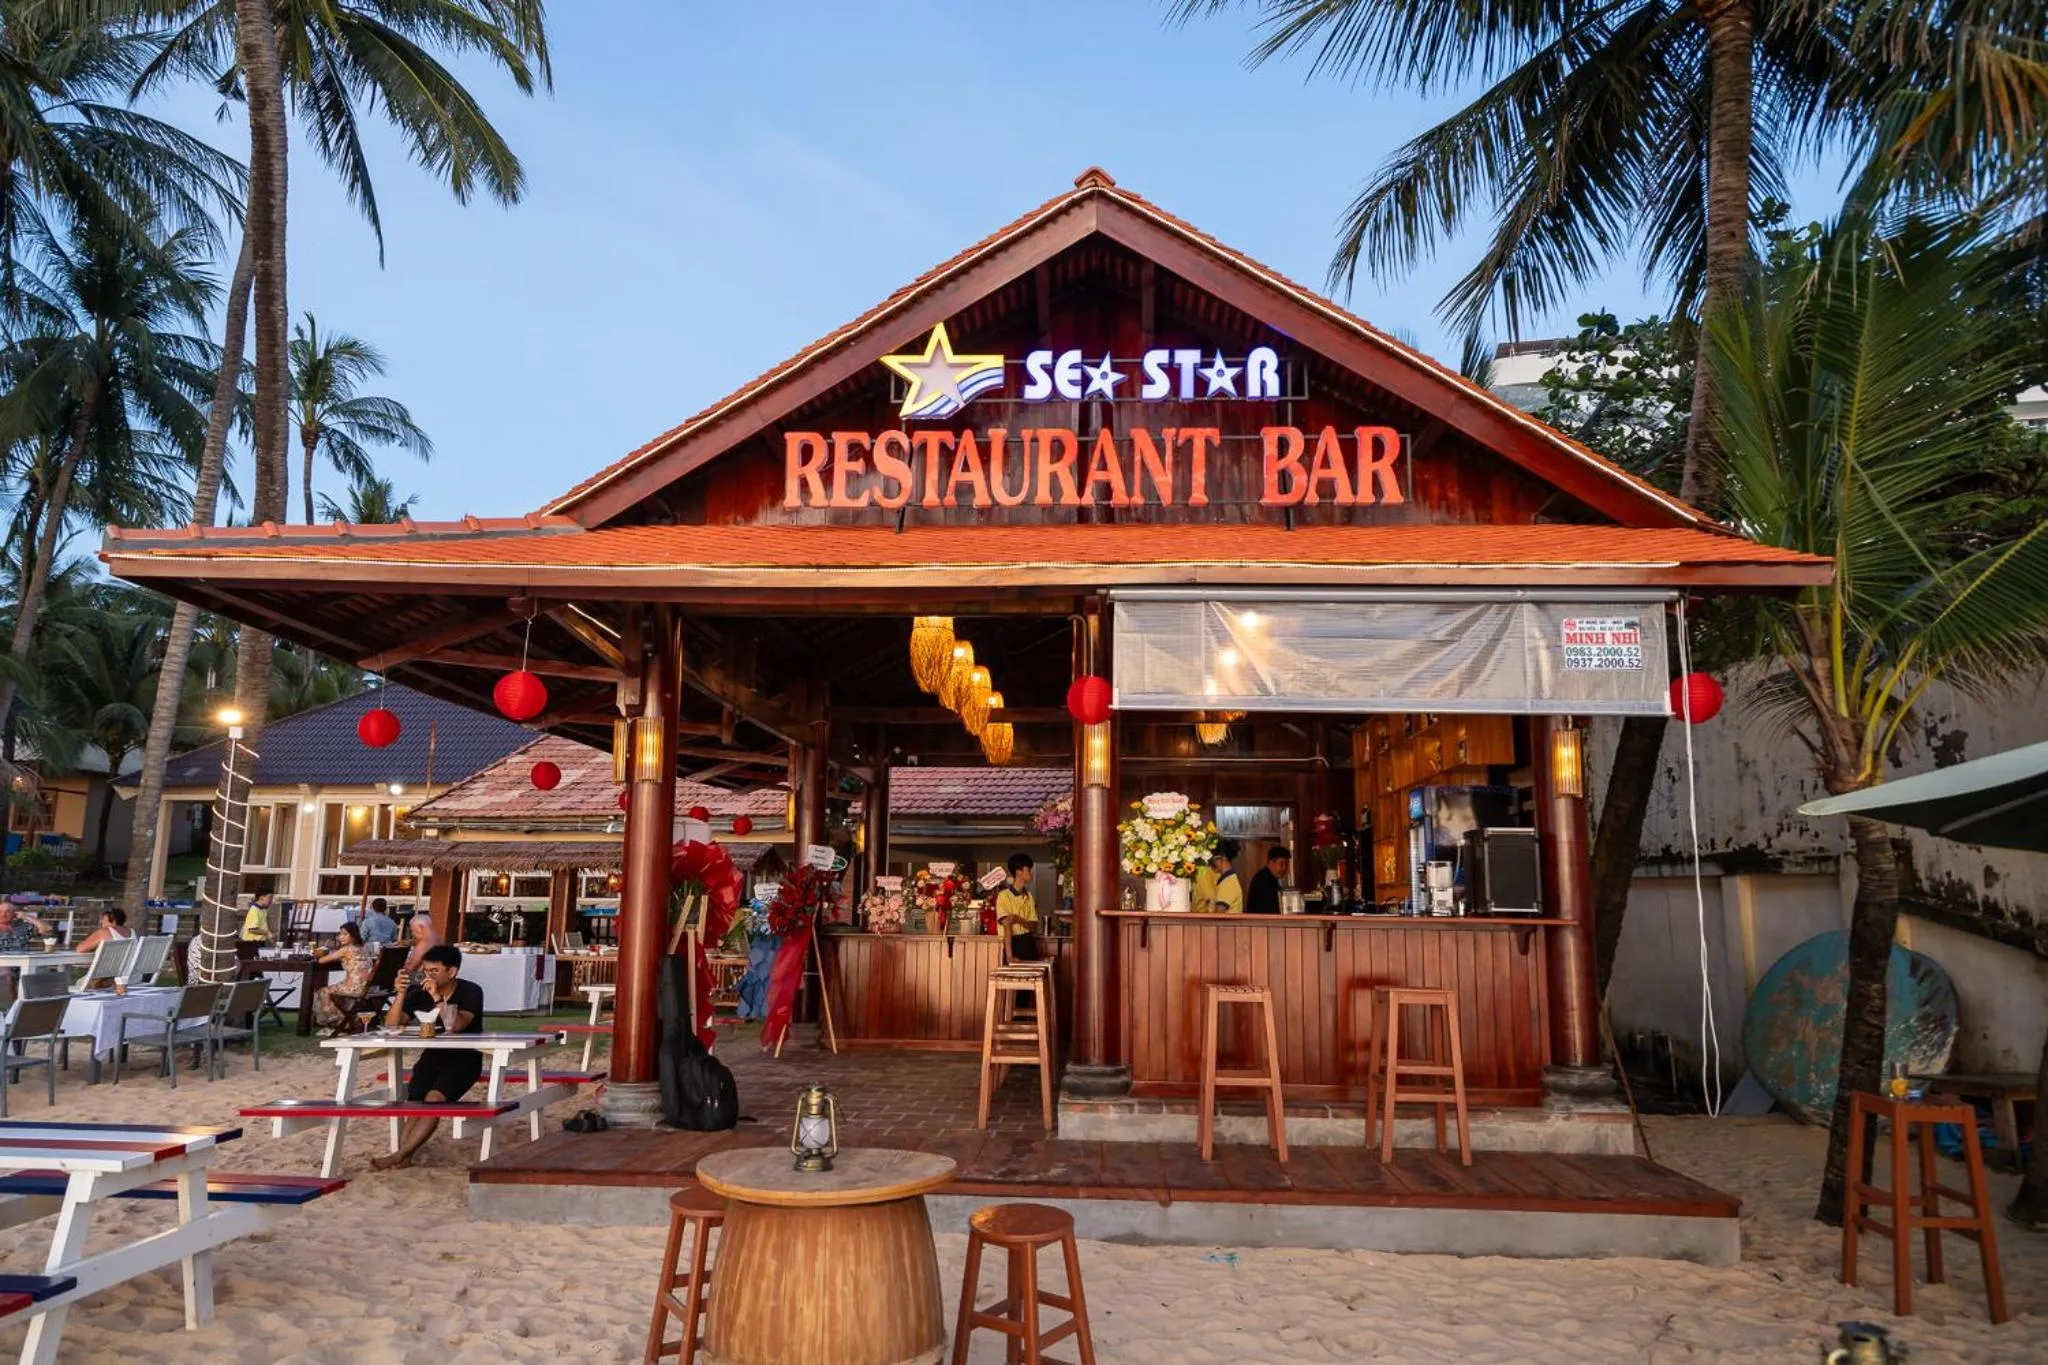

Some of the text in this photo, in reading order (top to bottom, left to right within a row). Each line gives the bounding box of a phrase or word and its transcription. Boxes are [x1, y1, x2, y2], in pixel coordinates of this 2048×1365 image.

[783, 425, 1405, 509] RESTAURANT BAR
[1565, 631, 1605, 645] MINH
[1565, 646, 1640, 657] 0983.2000.52
[1566, 657, 1642, 668] 0937.2000.52
